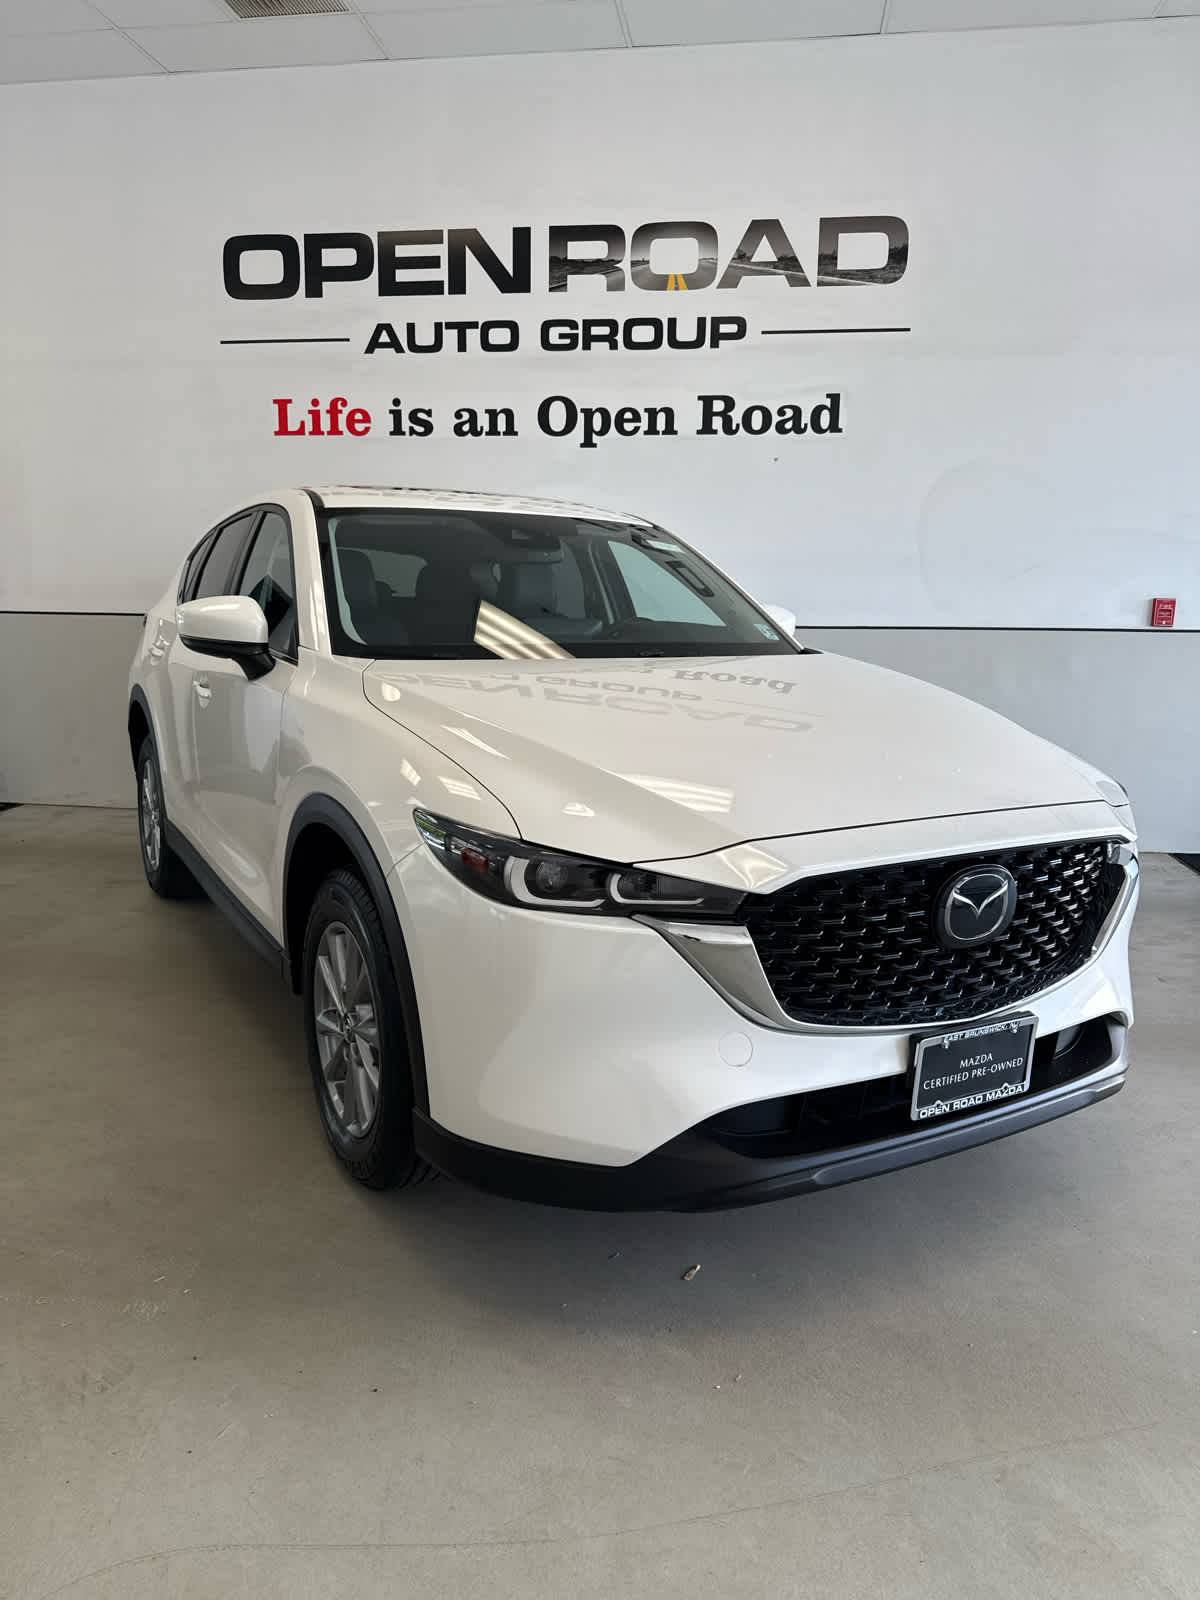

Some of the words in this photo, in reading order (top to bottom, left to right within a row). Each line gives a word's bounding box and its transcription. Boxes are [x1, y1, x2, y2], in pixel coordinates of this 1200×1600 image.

[223, 226, 531, 300] OPEN
[548, 216, 909, 292] ROAD
[364, 319, 520, 354] AUTO
[540, 316, 748, 352] GROUP
[273, 397, 372, 437] Life
[389, 398, 433, 437] is
[454, 408, 518, 437] an
[537, 396, 678, 448] Open
[696, 393, 843, 436] Road
[923, 1071, 969, 1090] CERTIFIED
[971, 1057, 1024, 1079] PRE-OWNED
[959, 1053, 993, 1069] MAZDA
[920, 1104, 950, 1118] OPEN
[953, 1095, 983, 1109] ROAD
[986, 1085, 1023, 1100] MAZDA
